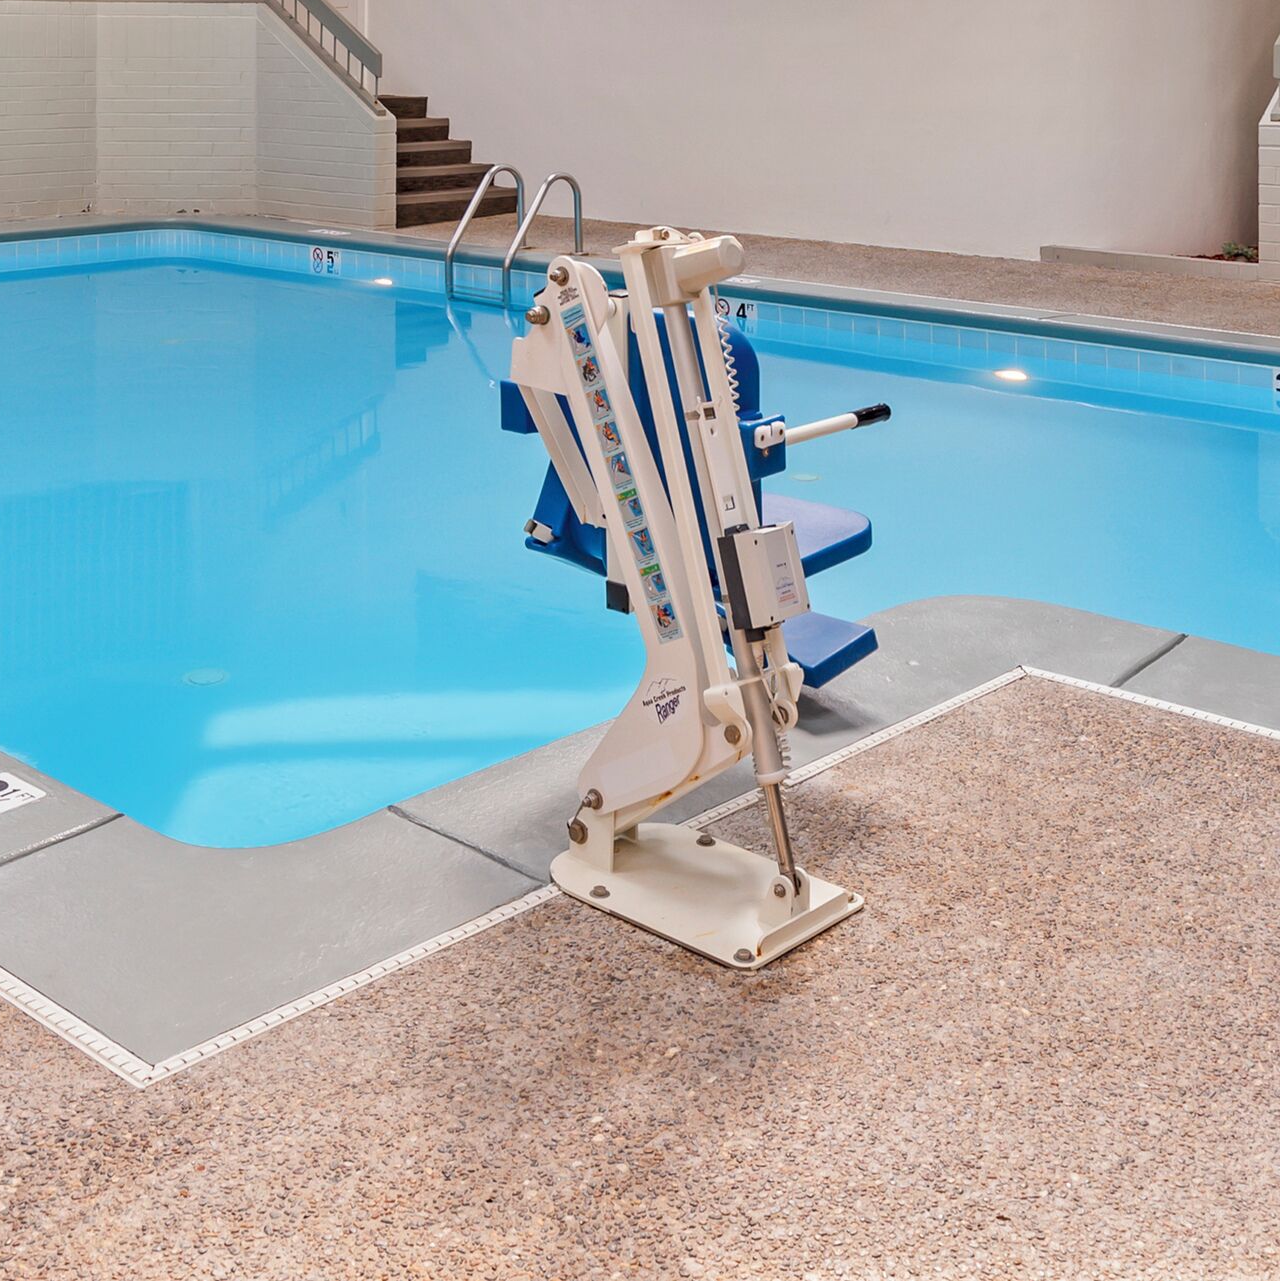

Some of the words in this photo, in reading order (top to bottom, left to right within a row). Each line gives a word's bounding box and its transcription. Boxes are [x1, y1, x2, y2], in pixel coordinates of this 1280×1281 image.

[327, 251, 334, 264] 5
[736, 303, 747, 318] 4
[747, 303, 754, 311] FT
[642, 698, 654, 707] Aqua
[653, 693, 666, 703] Creek
[666, 685, 686, 697] Products
[655, 694, 680, 725] Ranger
